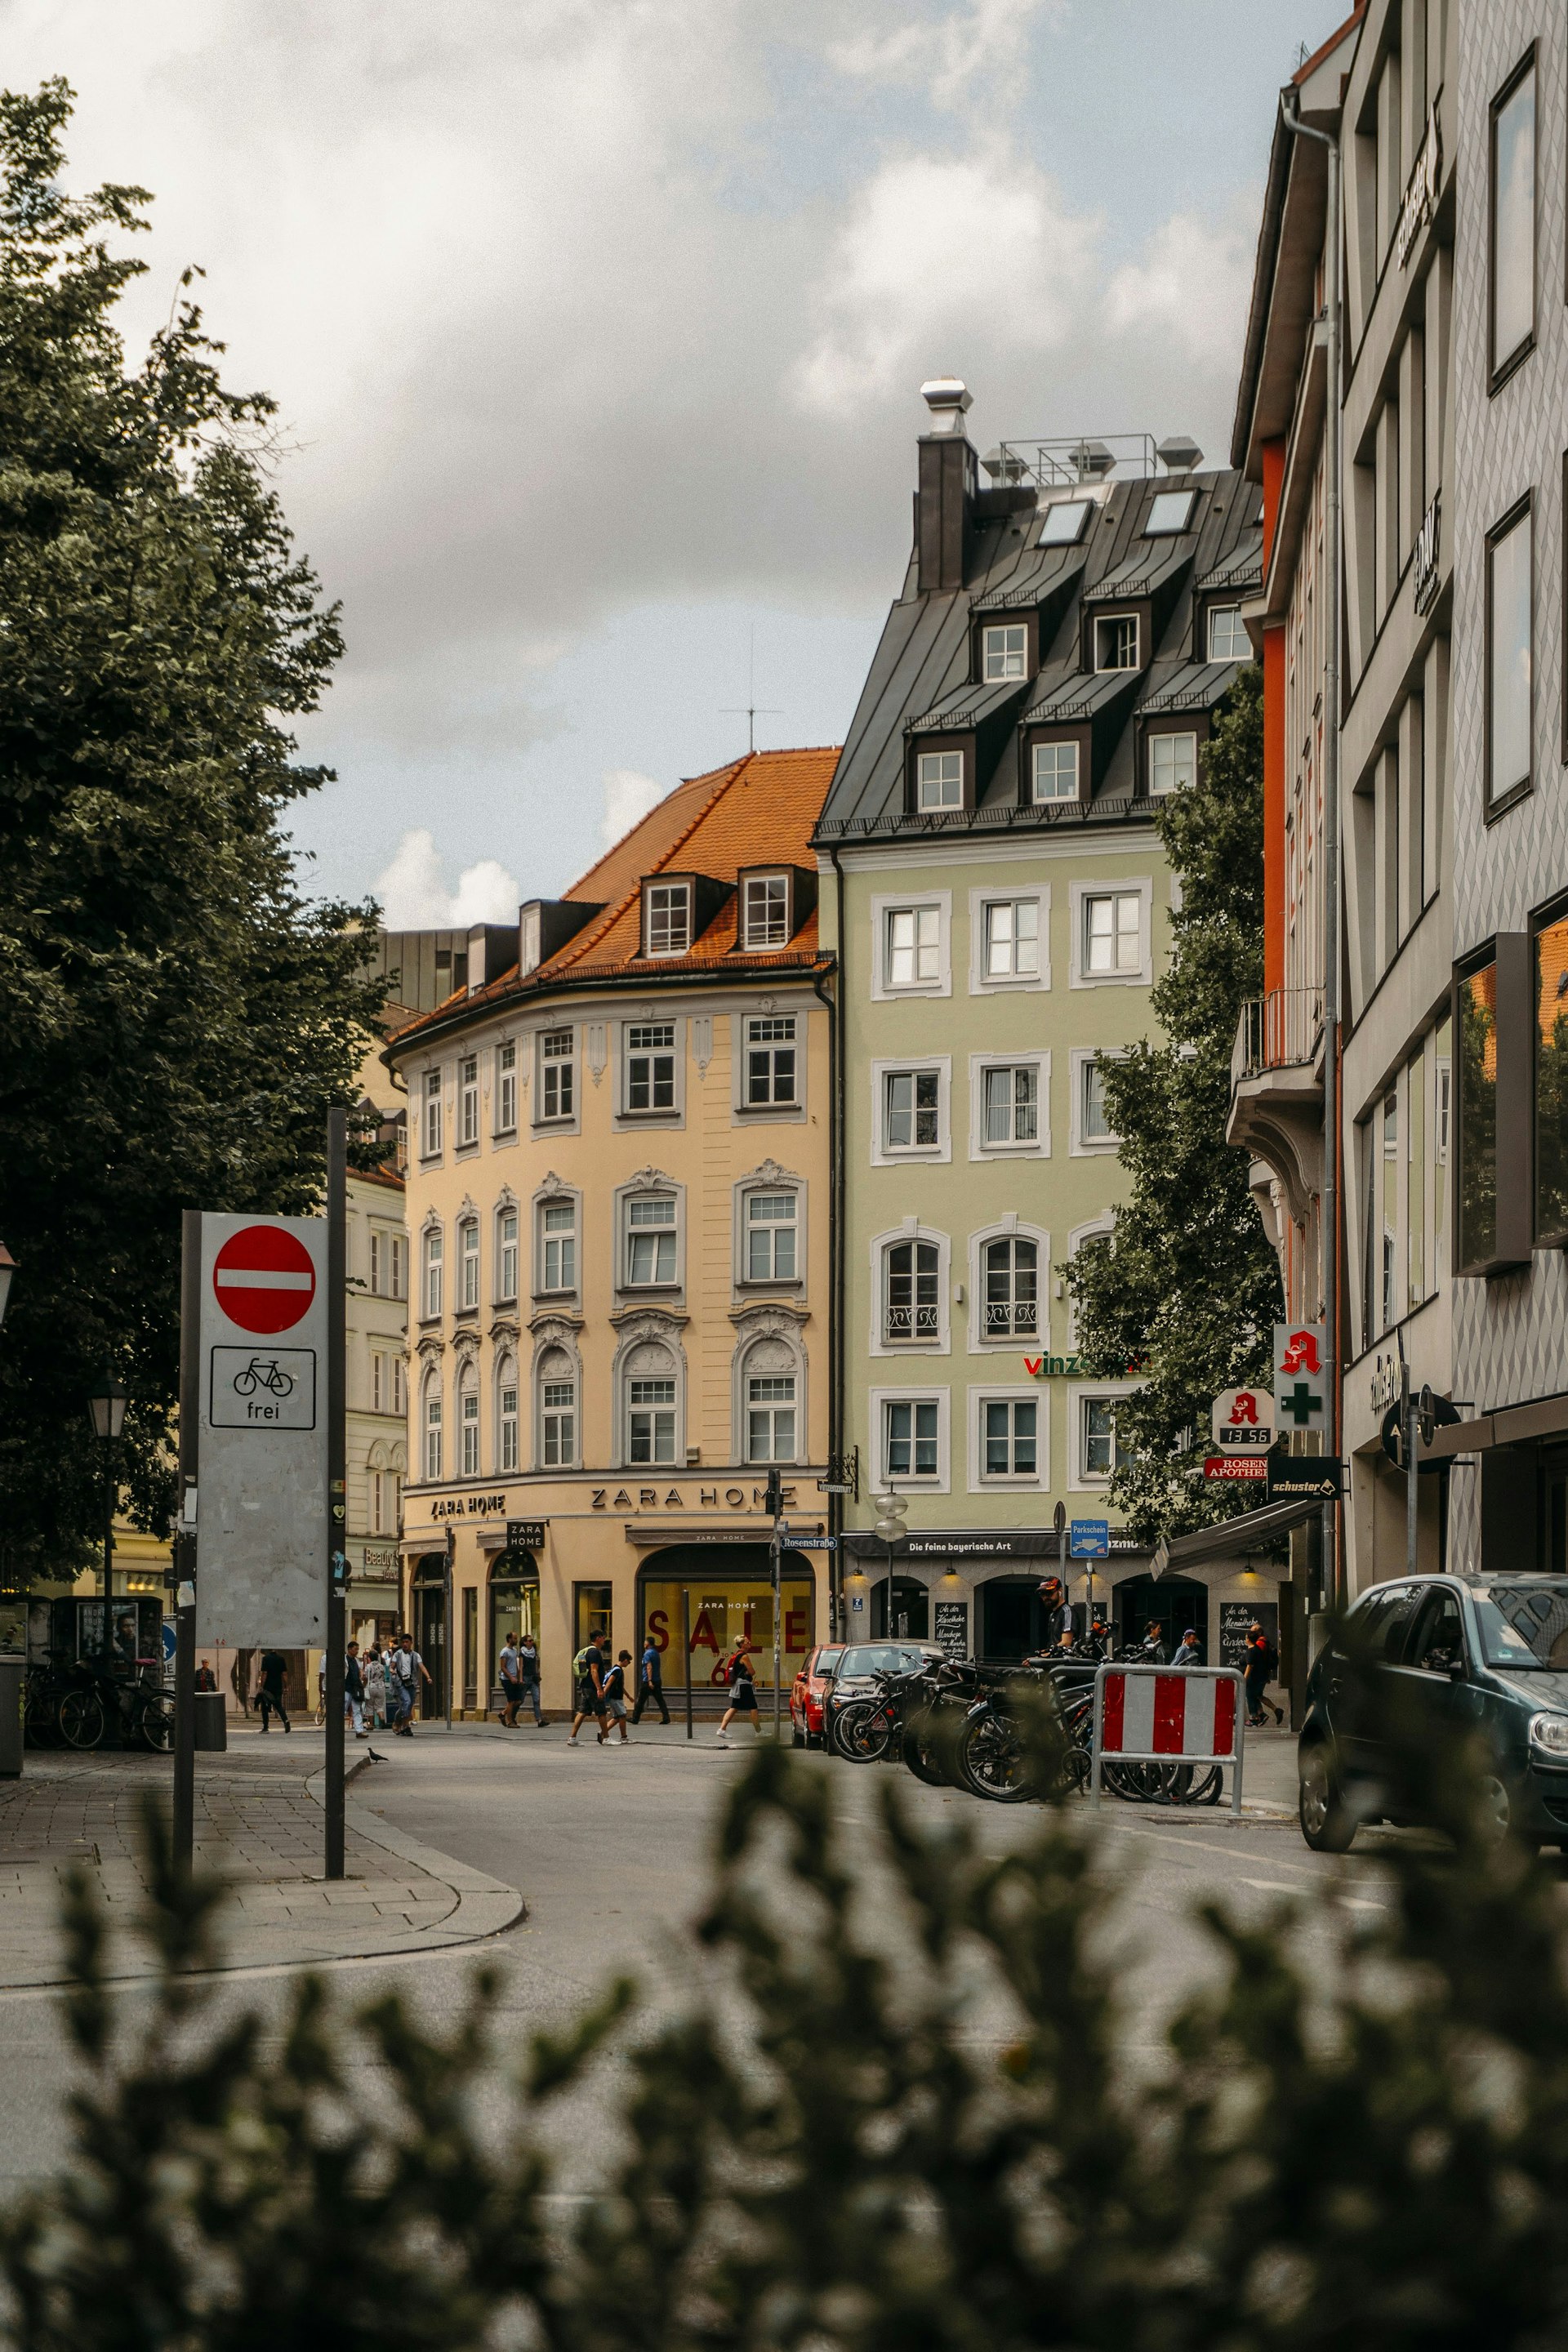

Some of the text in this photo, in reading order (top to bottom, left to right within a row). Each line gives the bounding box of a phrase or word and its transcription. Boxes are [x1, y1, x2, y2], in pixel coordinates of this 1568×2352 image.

[247, 1401, 278, 1419] frei
[1228, 1430, 1267, 1442] 13 56
[1223, 1459, 1267, 1468] ROSEN
[1272, 1481, 1321, 1491] schuster
[591, 1486, 797, 1507] ZARA HOME
[431, 1495, 506, 1517] ZARA HOME
[1073, 1526, 1106, 1534] Parkschein
[511, 1538, 541, 1546] HOME
[784, 1538, 835, 1548] Rosenstraße
[909, 1542, 1012, 1552] Die feine bayerische Art
[366, 1547, 394, 1570] Beauty
[648, 1610, 805, 1654] SALE
